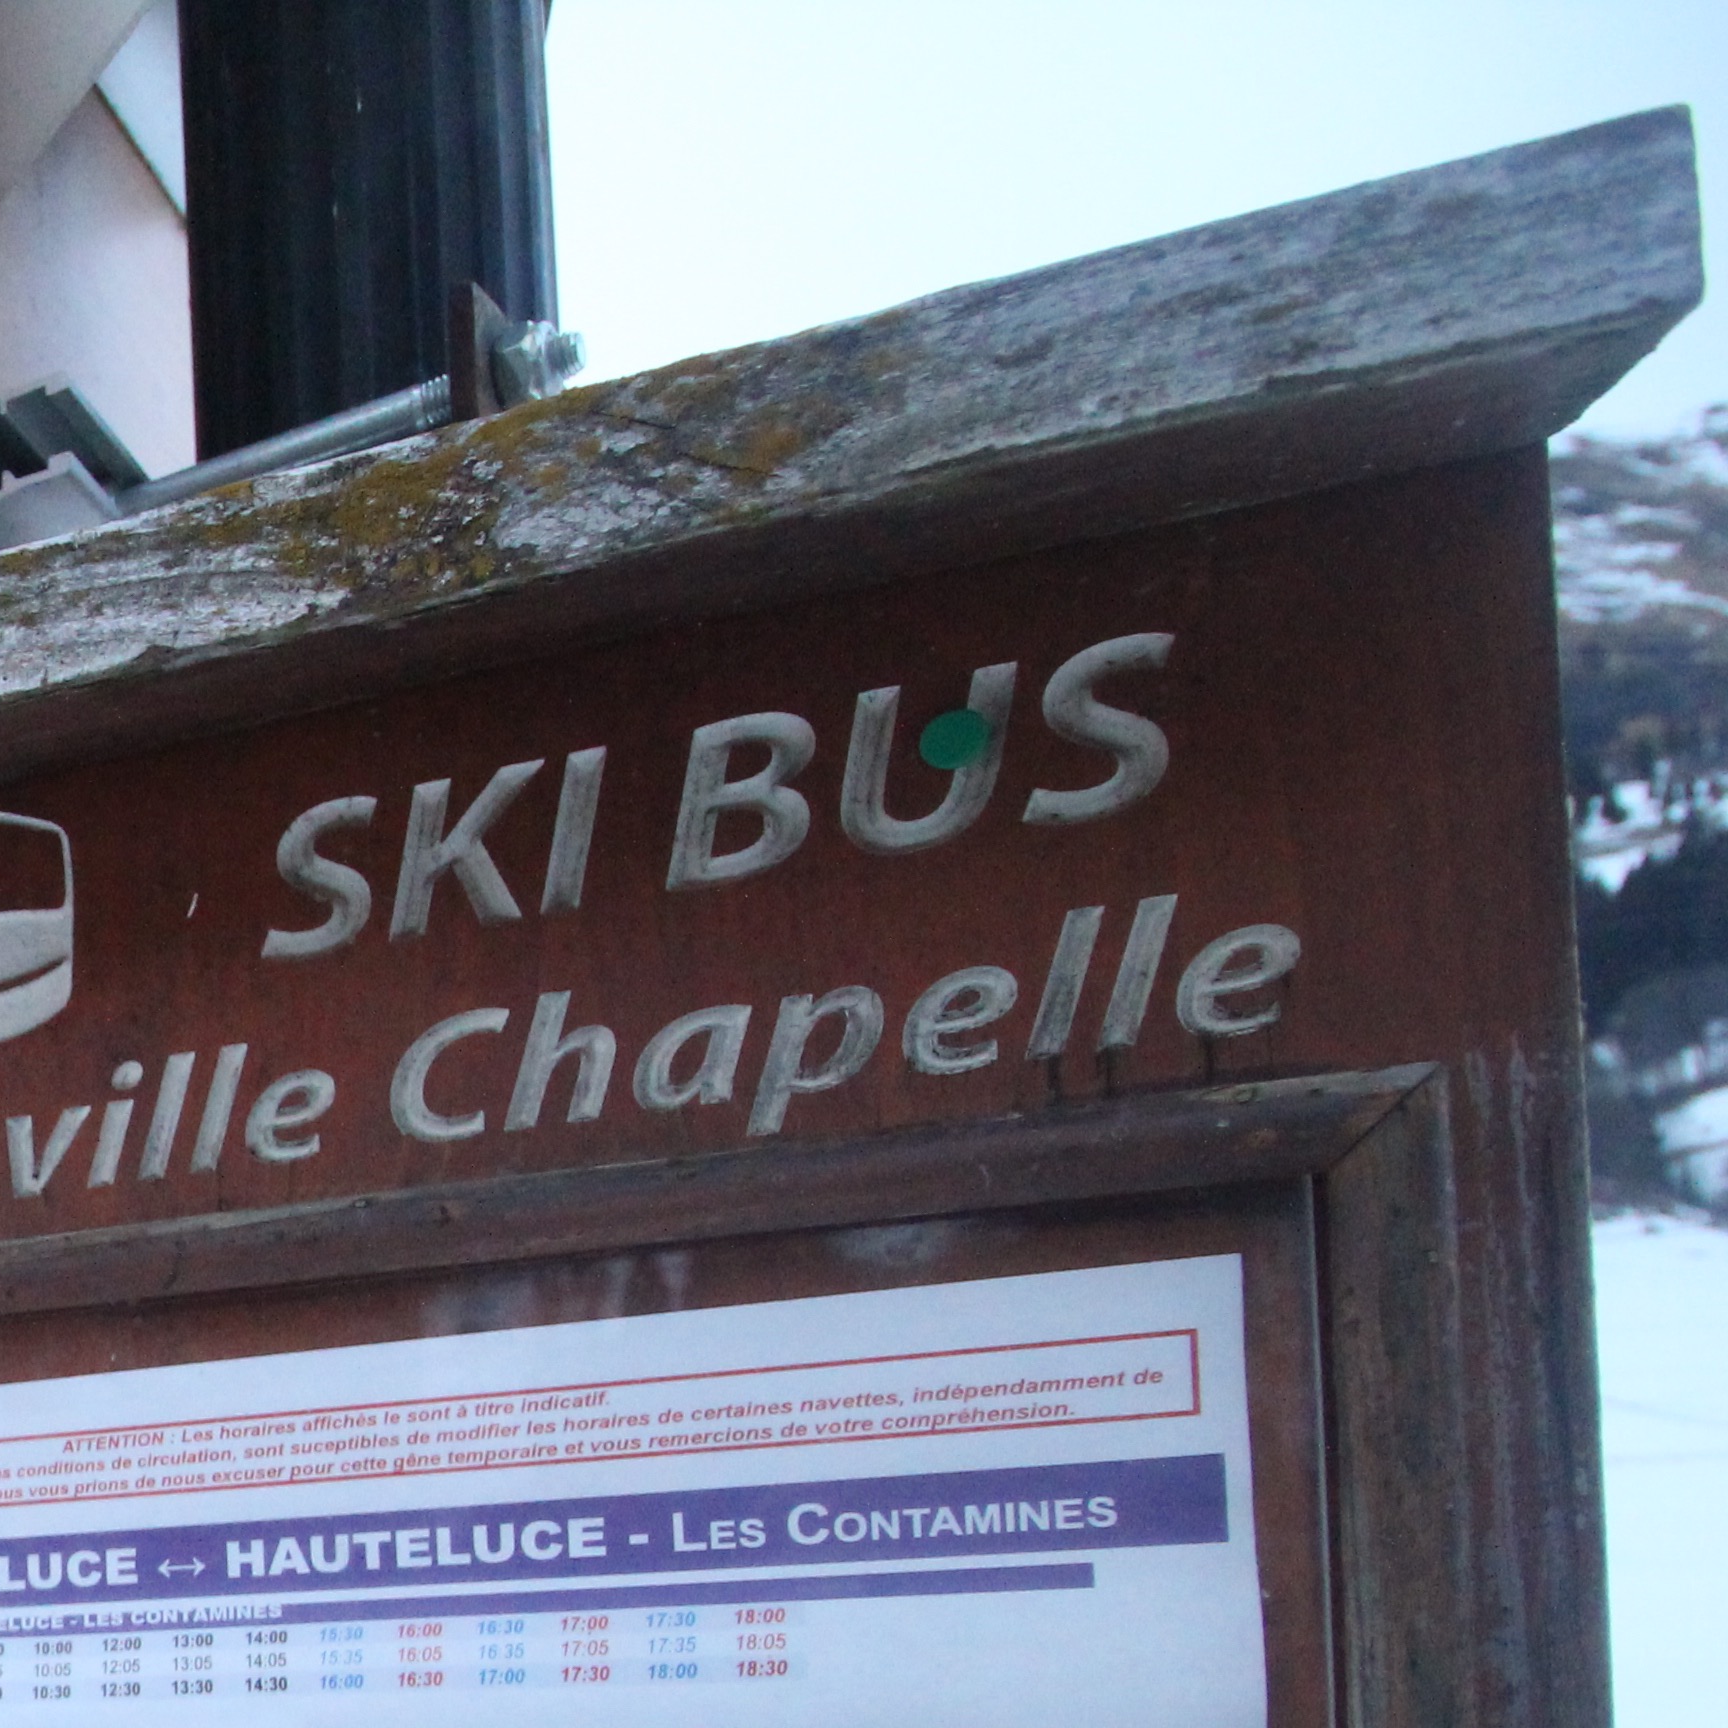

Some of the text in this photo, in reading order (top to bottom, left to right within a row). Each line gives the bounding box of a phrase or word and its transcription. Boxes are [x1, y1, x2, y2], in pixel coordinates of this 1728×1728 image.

[261, 631, 1178, 963] SKI BUS
[390, 893, 1303, 1140] Chapelle
[17, 1457, 105, 1478] conditions
[137, 1447, 237, 1468] circulation,
[244, 1442, 285, 1459] sont
[290, 1432, 400, 1456] suceptibles
[407, 1429, 431, 1445] de
[437, 1422, 520, 1442] modifier
[527, 1420, 556, 1435] les
[563, 1412, 650, 1432] horaires
[658, 1408, 684, 1424] de
[690, 1401, 792, 1421] certaines
[799, 1391, 904, 1412] navettes,
[913, 1371, 1126, 1403] indépendamment
[1133, 1369, 1164, 1385] de
[28, 1483, 69, 1498] vous
[74, 1478, 129, 1499] prions
[135, 1474, 156, 1490] de
[161, 1472, 205, 1488] nous
[212, 1465, 285, 1483] excuser
[289, 1460, 334, 1481] pour
[340, 1456, 387, 1473] cette
[393, 1451, 441, 1474] gêne
[447, 1443, 558, 1467] temporaire
[590, 1436, 642, 1453] vous
[648, 1426, 772, 1448] remercions
[816, 1417, 873, 1437] votre
[881, 1404, 1076, 1431] compréhension.
[63, 1390, 610, 1453] ATTENTION Les horaires affichés sont titre indicatif.
[226, 1517, 606, 1578] HAUTELUCE
[83, 1611, 126, 1628] LES
[131, 1603, 283, 1625] CONTAMINES
[560, 1608, 786, 1632] 17:00 17:30 18:00
[33, 1684, 71, 1700] 10:30
[100, 1681, 141, 1698] 12:30
[171, 1679, 213, 1695] 13:30
[245, 1676, 288, 1693] 14:30
[397, 1671, 443, 1688] 16:30
[478, 1668, 526, 1685] 17:00
[560, 1666, 610, 1683] 17:30
[647, 1663, 698, 1681] 18:00
[736, 1660, 788, 1677] 18:30
